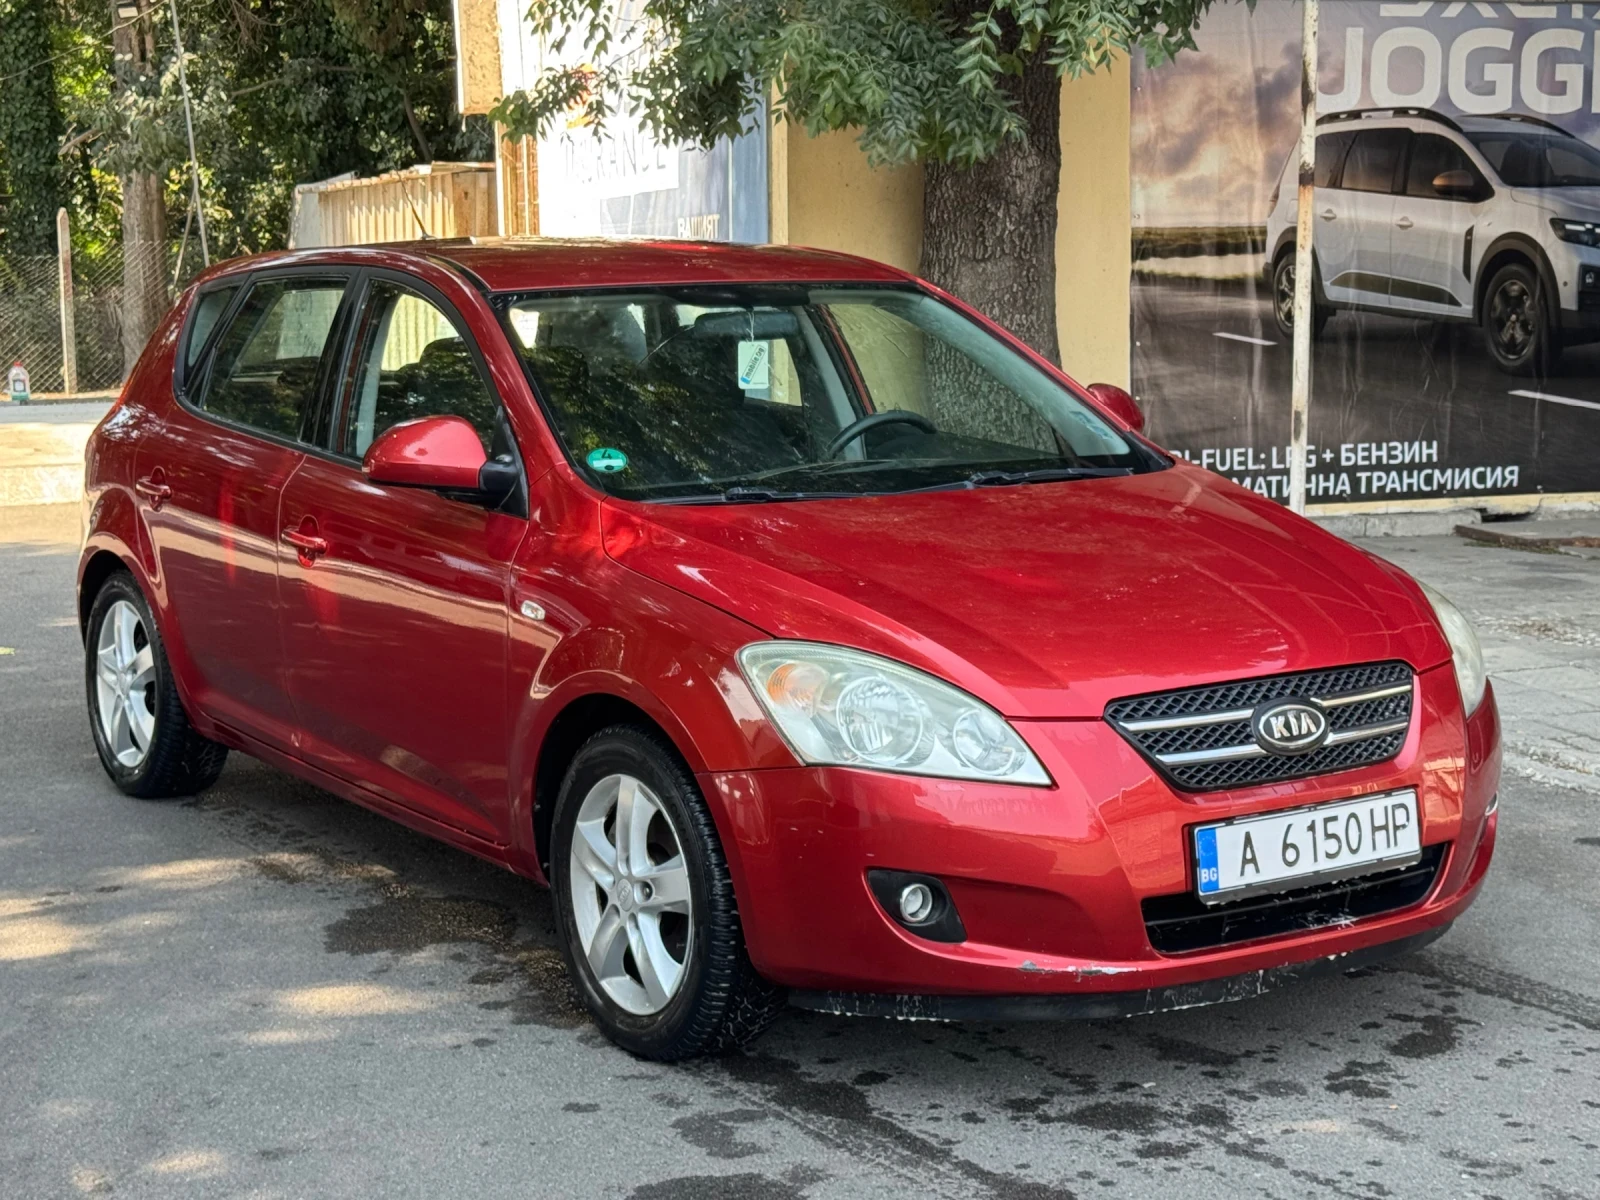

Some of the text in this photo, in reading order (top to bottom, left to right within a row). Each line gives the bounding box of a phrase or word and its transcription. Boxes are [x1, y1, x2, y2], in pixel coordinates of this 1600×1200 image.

[1316, 26, 1600, 116] JOGG
[601, 449, 613, 460] 4
[1322, 448, 1335, 463] +
[1339, 440, 1439, 467] БЕНЗИН
[1355, 465, 1520, 495] ТРАНСМИСИЯ
[1269, 709, 1318, 739] KIA
[1239, 830, 1261, 877] A
[1201, 867, 1218, 883] BG
